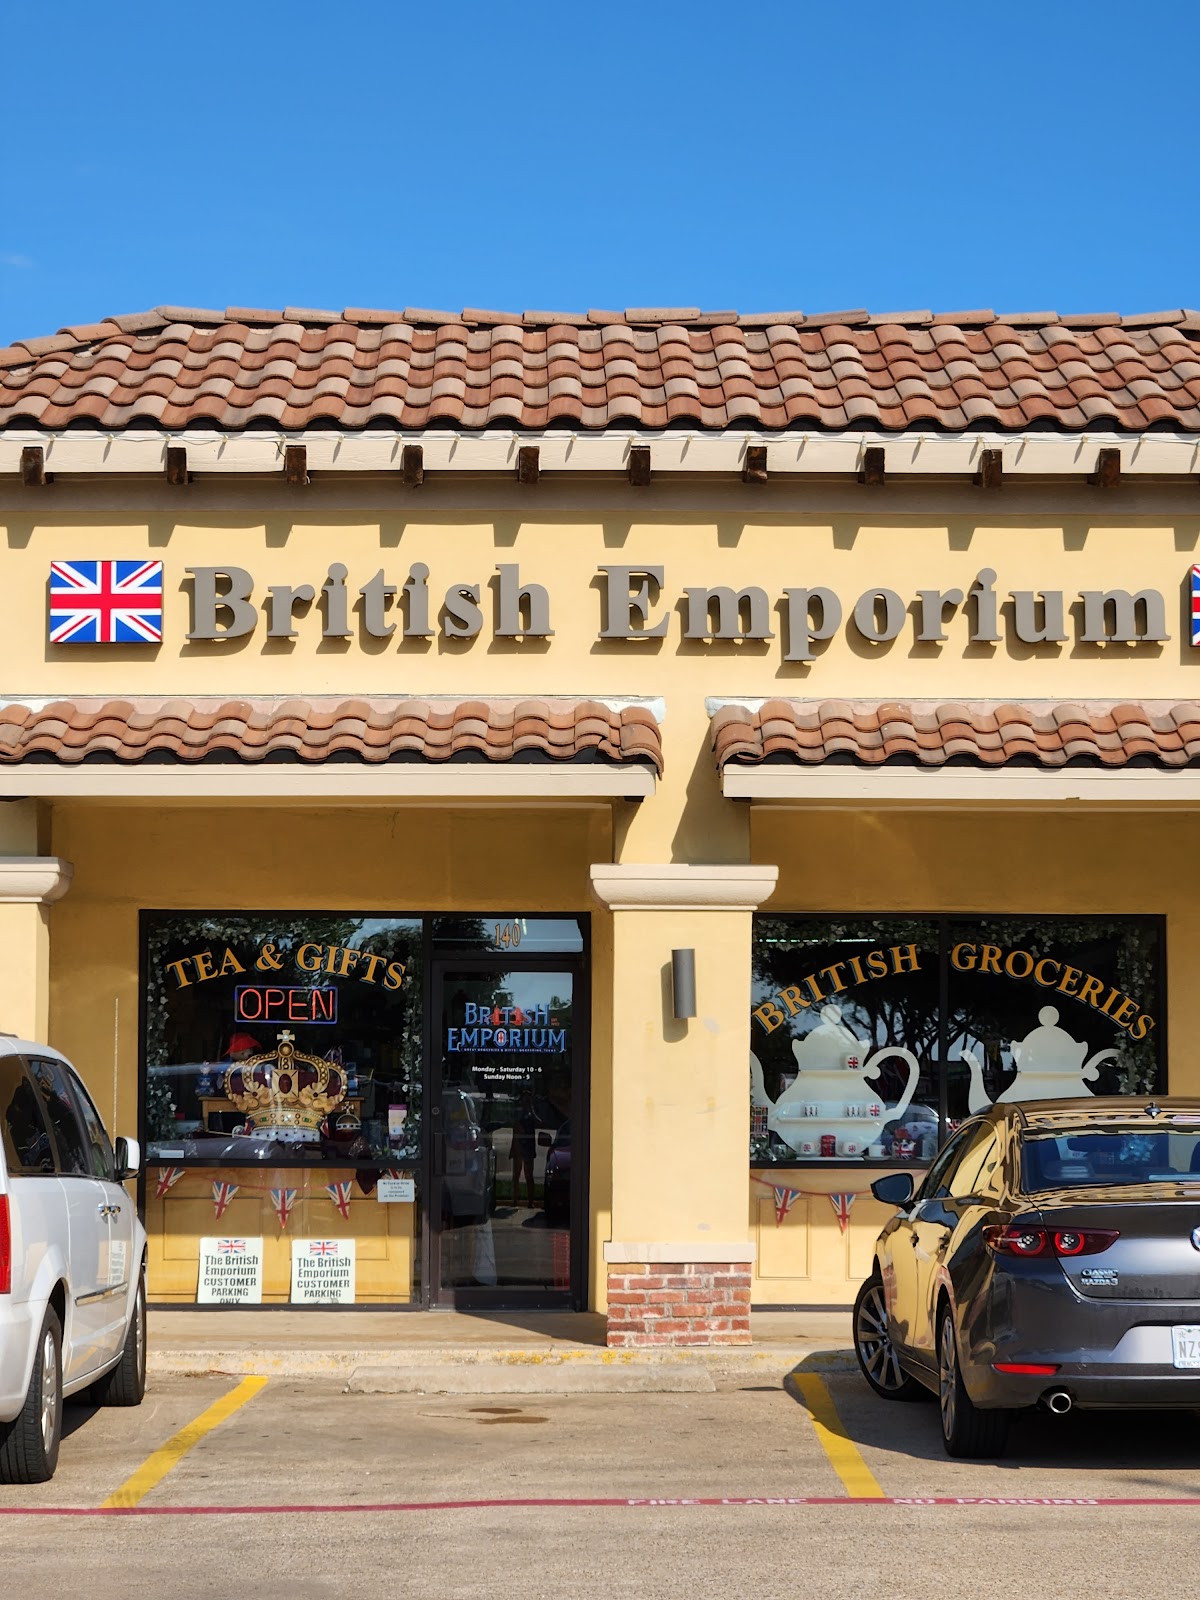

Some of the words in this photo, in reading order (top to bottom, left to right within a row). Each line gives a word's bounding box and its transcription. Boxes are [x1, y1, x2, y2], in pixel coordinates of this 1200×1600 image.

[185, 562, 555, 640] British
[597, 565, 1172, 662] Emporium
[495, 923, 521, 948] 140
[166, 947, 247, 990] TEA
[254, 943, 285, 971] &
[296, 943, 407, 991] GIFTS
[752, 943, 923, 1035] BRITISH
[951, 942, 1157, 1041] GROCERIES
[239, 988, 333, 1021] OPEN
[447, 1028, 567, 1053] EMPORIUM
[205, 1256, 223, 1265] The
[225, 1255, 259, 1265] British
[297, 1258, 315, 1267] The
[317, 1257, 351, 1267] British
[205, 1266, 256, 1276] Emporium
[299, 1269, 349, 1279] Emporium
[204, 1277, 257, 1286] CUSTOMER
[297, 1280, 350, 1288] CUSTOMER
[211, 1288, 249, 1296] PARKING
[304, 1290, 341, 1298] PARKING
